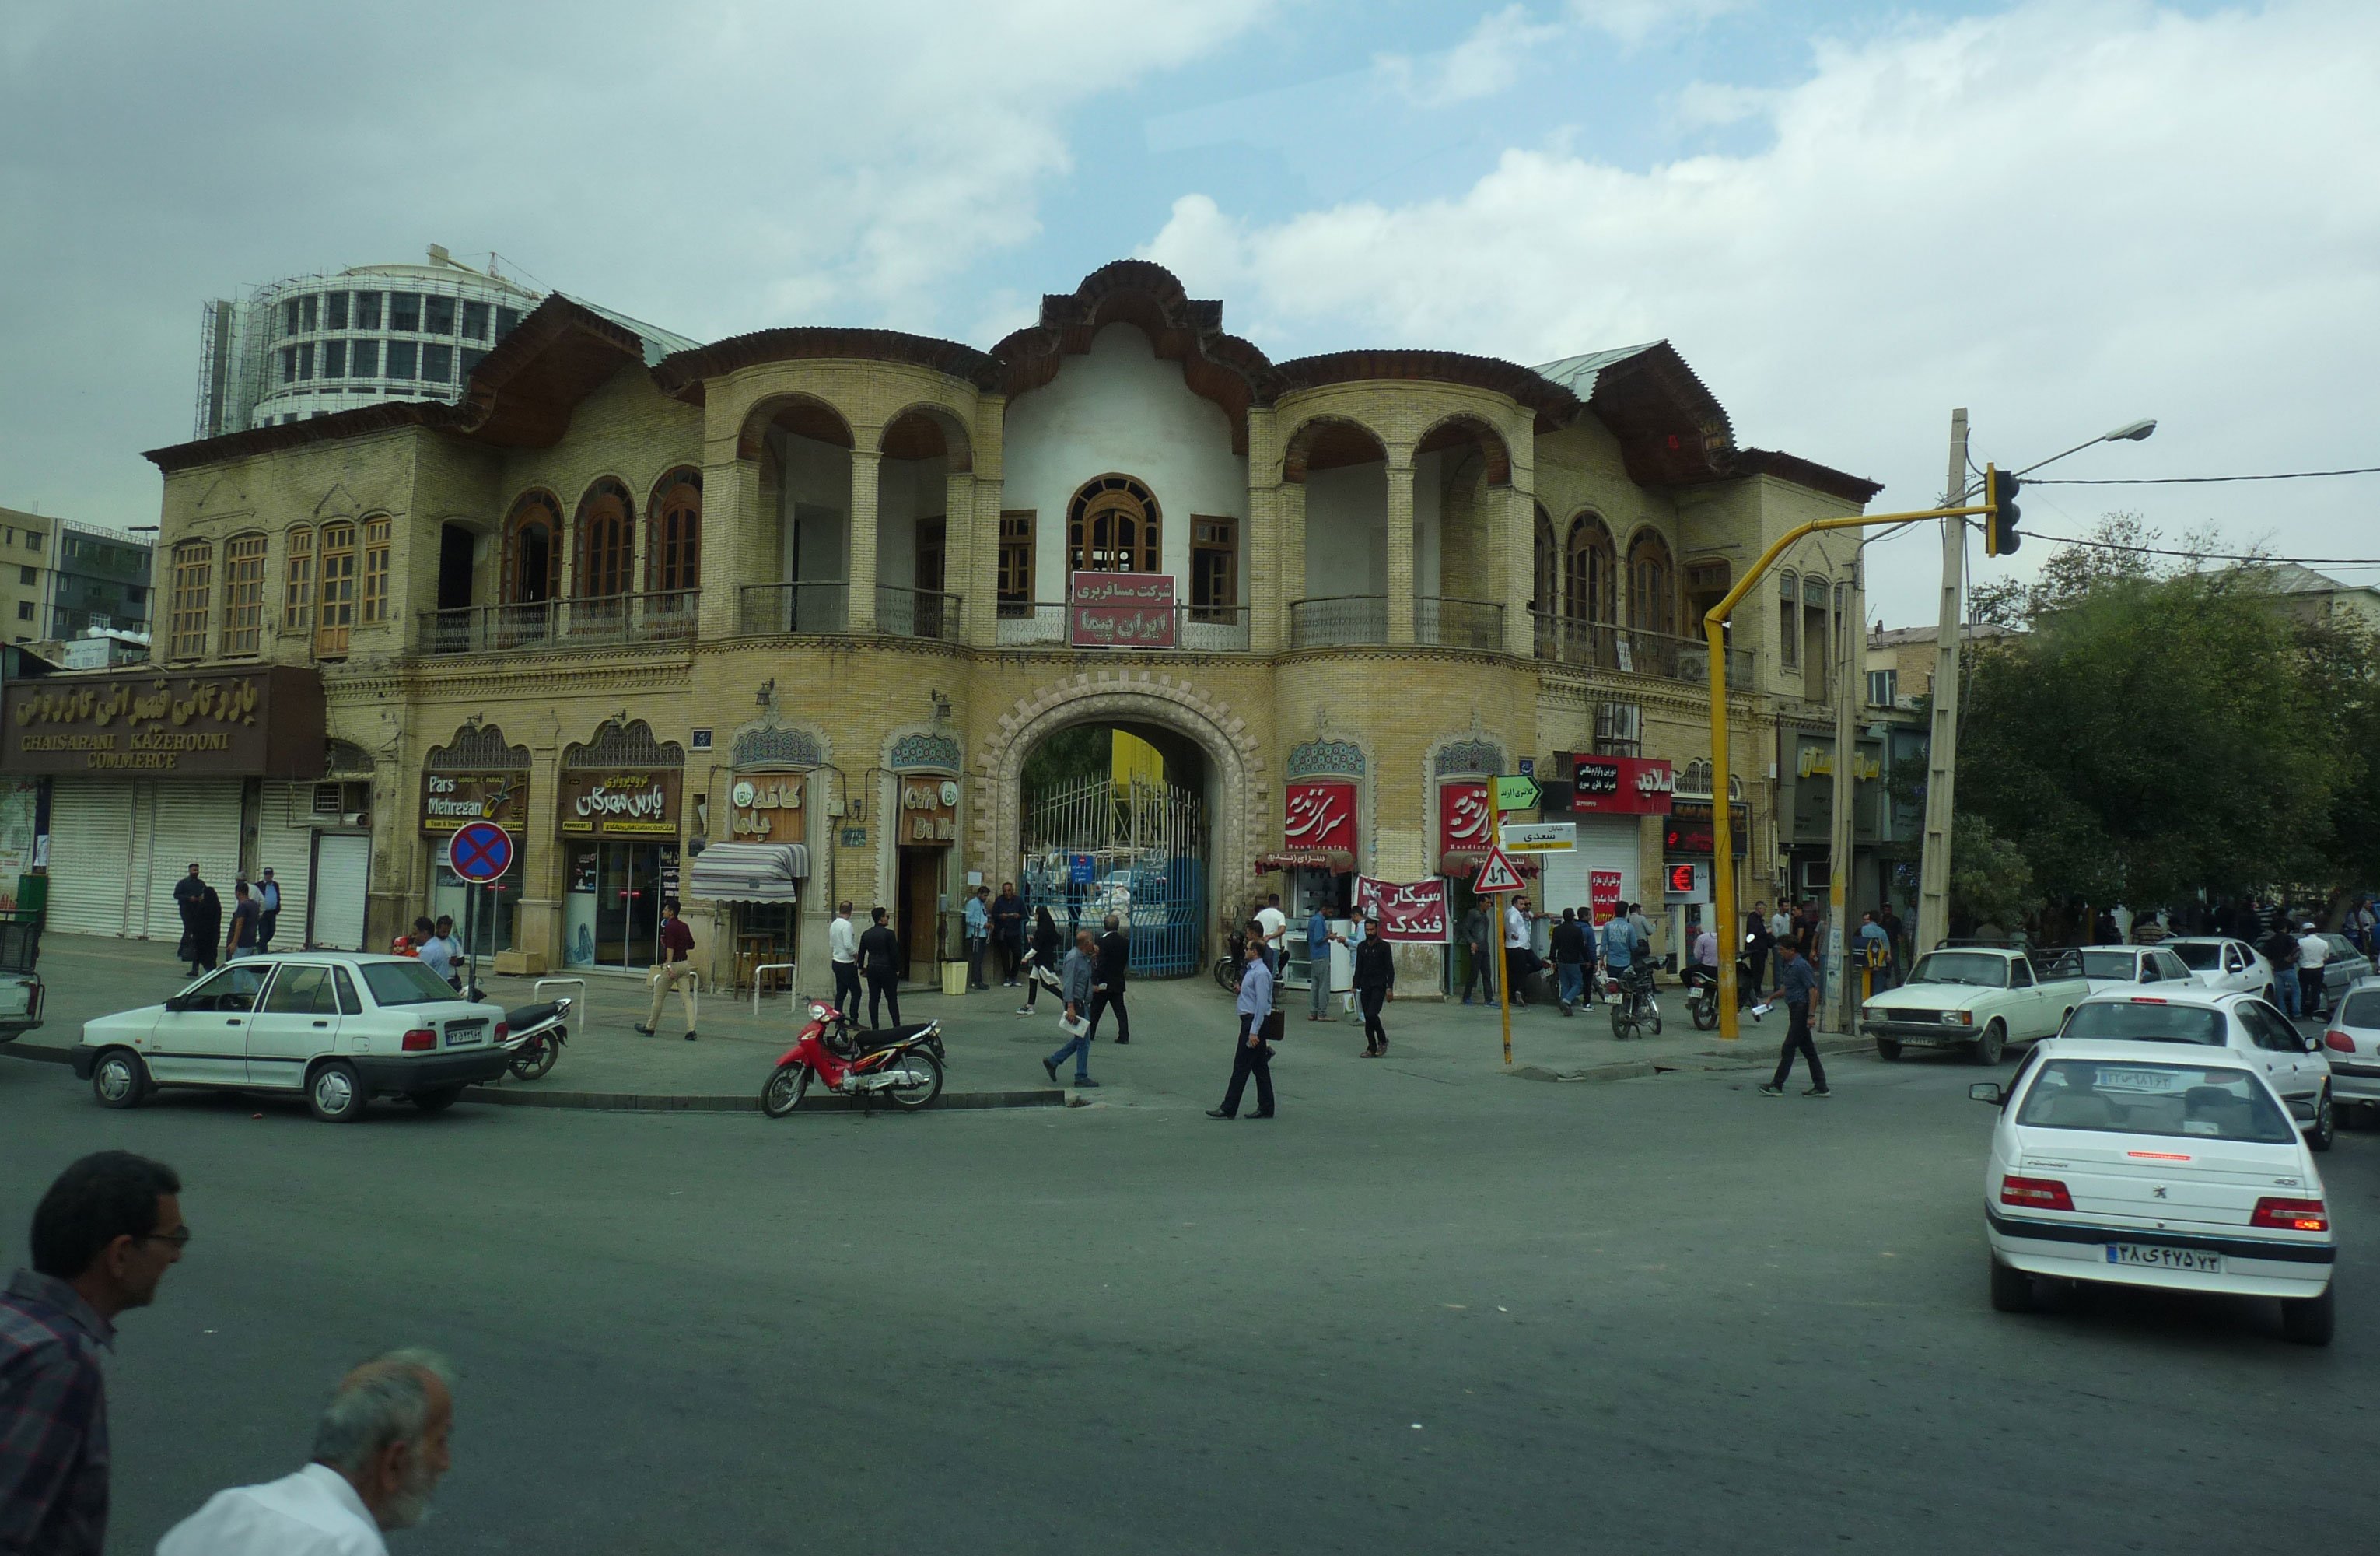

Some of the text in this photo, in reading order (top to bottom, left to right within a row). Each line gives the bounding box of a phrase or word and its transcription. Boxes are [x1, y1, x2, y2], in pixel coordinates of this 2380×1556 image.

[1076, 581, 1171, 601] شرکت مسافربری
[1080, 609, 1167, 642] ایران پیما
[16, 685, 95, 727] کازرونی
[171, 678, 257, 727] بازرگانی
[129, 732, 231, 750] KAZEROONI
[87, 752, 177, 769] COMMERCE
[429, 776, 455, 793] Pars
[576, 784, 663, 819] پارس مهرگان
[753, 783, 802, 809] کافه
[428, 797, 481, 816] Mehregan
[913, 817, 957, 840] Ba Ma
[1524, 832, 1556, 843] سعدی
[1267, 853, 1325, 864] سرای زندیه
[1386, 916, 1443, 934] فندک
